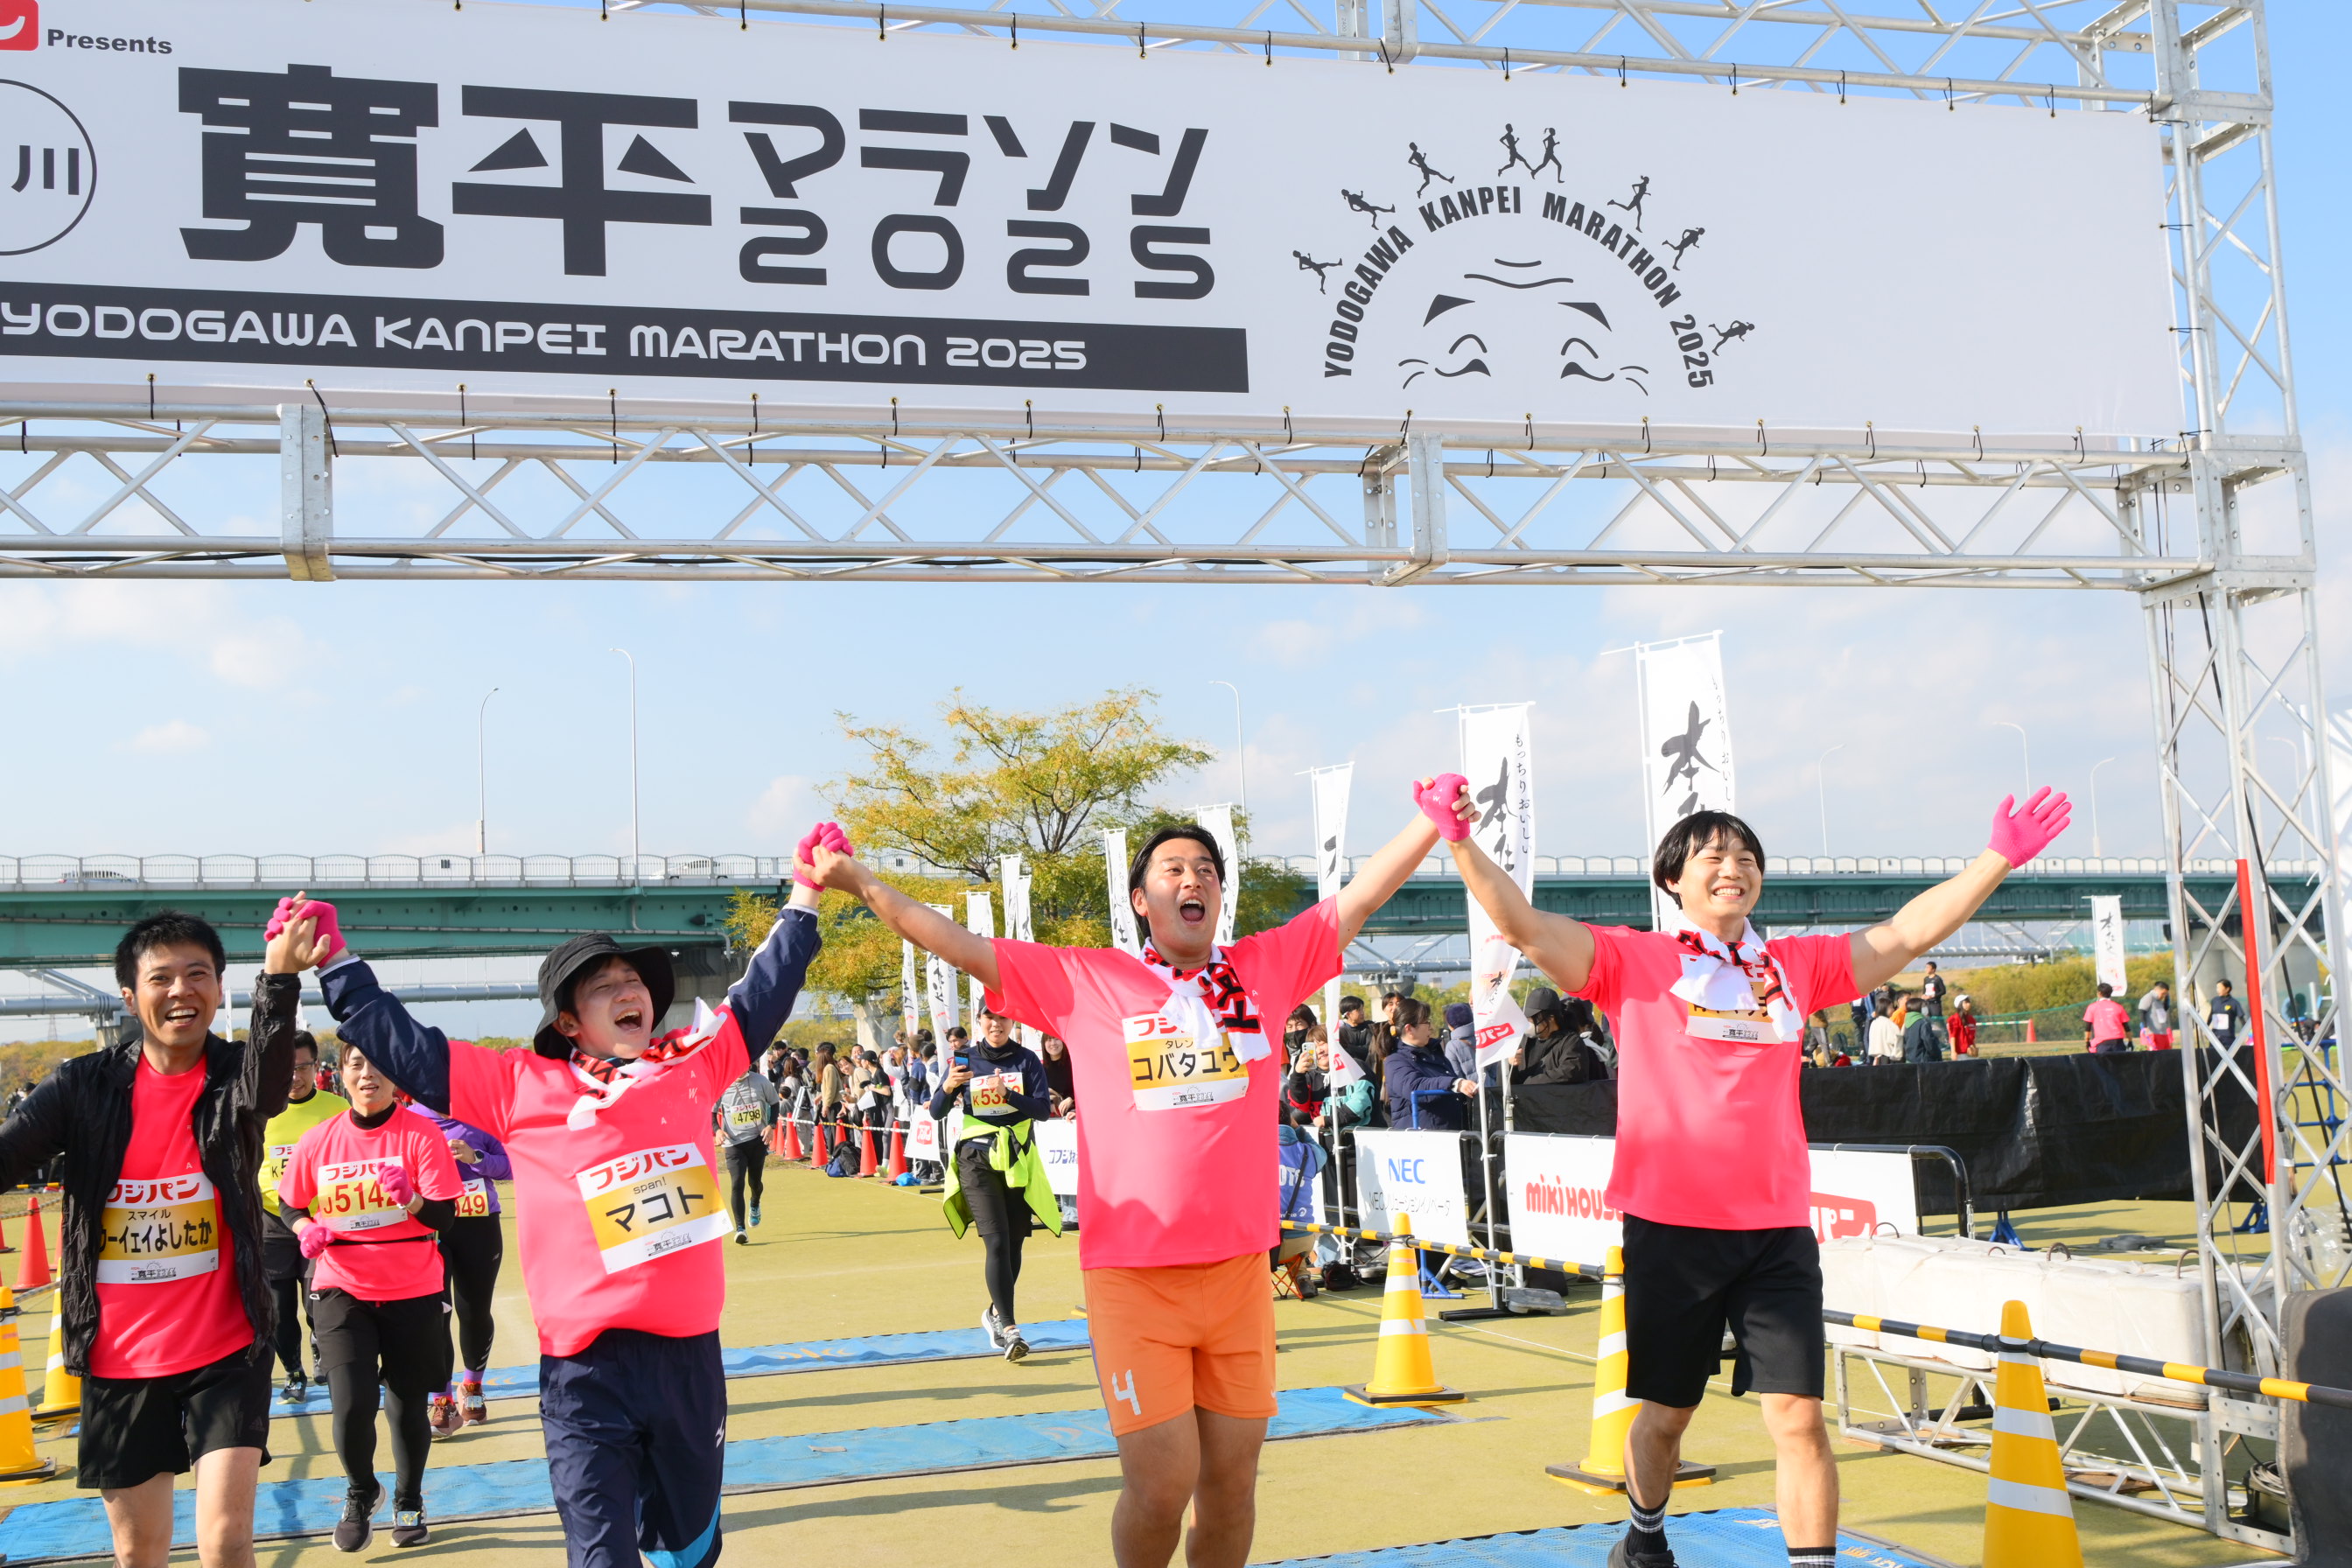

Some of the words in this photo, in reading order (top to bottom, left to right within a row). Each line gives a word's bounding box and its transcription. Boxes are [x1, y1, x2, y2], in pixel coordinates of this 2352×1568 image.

[47, 29, 172, 54] Presents
[738, 206, 1215, 300] 2025
[1324, 225, 1415, 378] YODOGAWA
[1418, 186, 1522, 233] KANPEI
[1542, 192, 1682, 308] MARATHON
[1670, 313, 1715, 388] 2025
[2, 302, 358, 347] YODOGAWA
[374, 317, 607, 356] KANPEI
[629, 325, 927, 367] MARATHON
[945, 336, 1087, 371] 2025
[1711, 672, 1732, 813] もっちりおいし
[1515, 733, 1532, 855] もっちりおいしい
[1165, 1039, 1194, 1050] タレン
[326, 1162, 379, 1181] フジパ
[589, 1149, 690, 1191] フジパン
[633, 1176, 668, 1195] span!
[1388, 1158, 1426, 1185] NEC
[127, 1208, 172, 1222] スマイル
[323, 1181, 398, 1214] J514
[605, 1186, 704, 1233] マコト
[1111, 1368, 1142, 1416] 4
